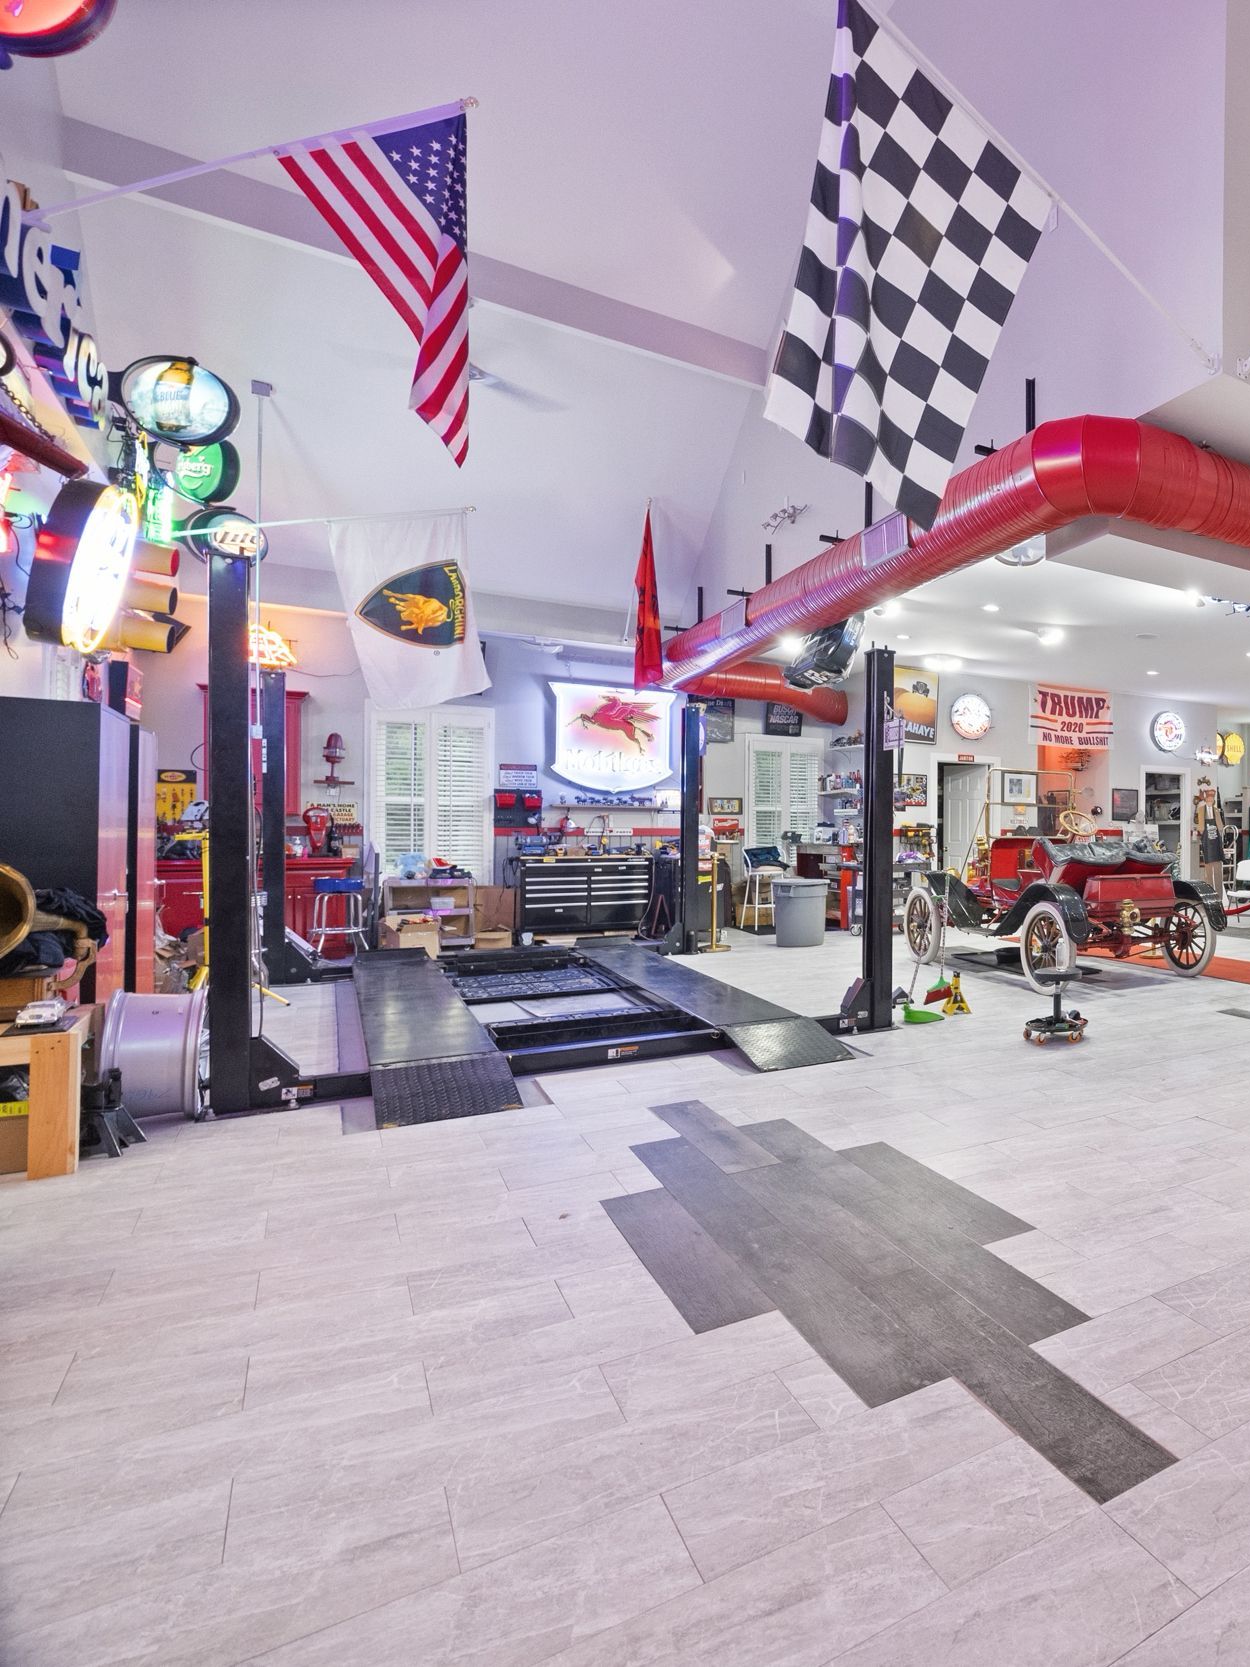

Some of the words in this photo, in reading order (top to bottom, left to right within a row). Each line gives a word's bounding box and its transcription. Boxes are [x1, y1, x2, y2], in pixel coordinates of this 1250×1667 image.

[443, 564, 466, 639] LAMBORGHINI
[1037, 689, 1107, 719] TRUMP
[768, 715, 799, 724] NASCAR
[1060, 721, 1084, 733] 2020
[905, 721, 935, 739] LAHAYE
[1042, 731, 1053, 742] NO
[1054, 734, 1074, 745] MORE
[1077, 736, 1109, 746] BULLSHIT
[1226, 744, 1242, 753] SHELL
